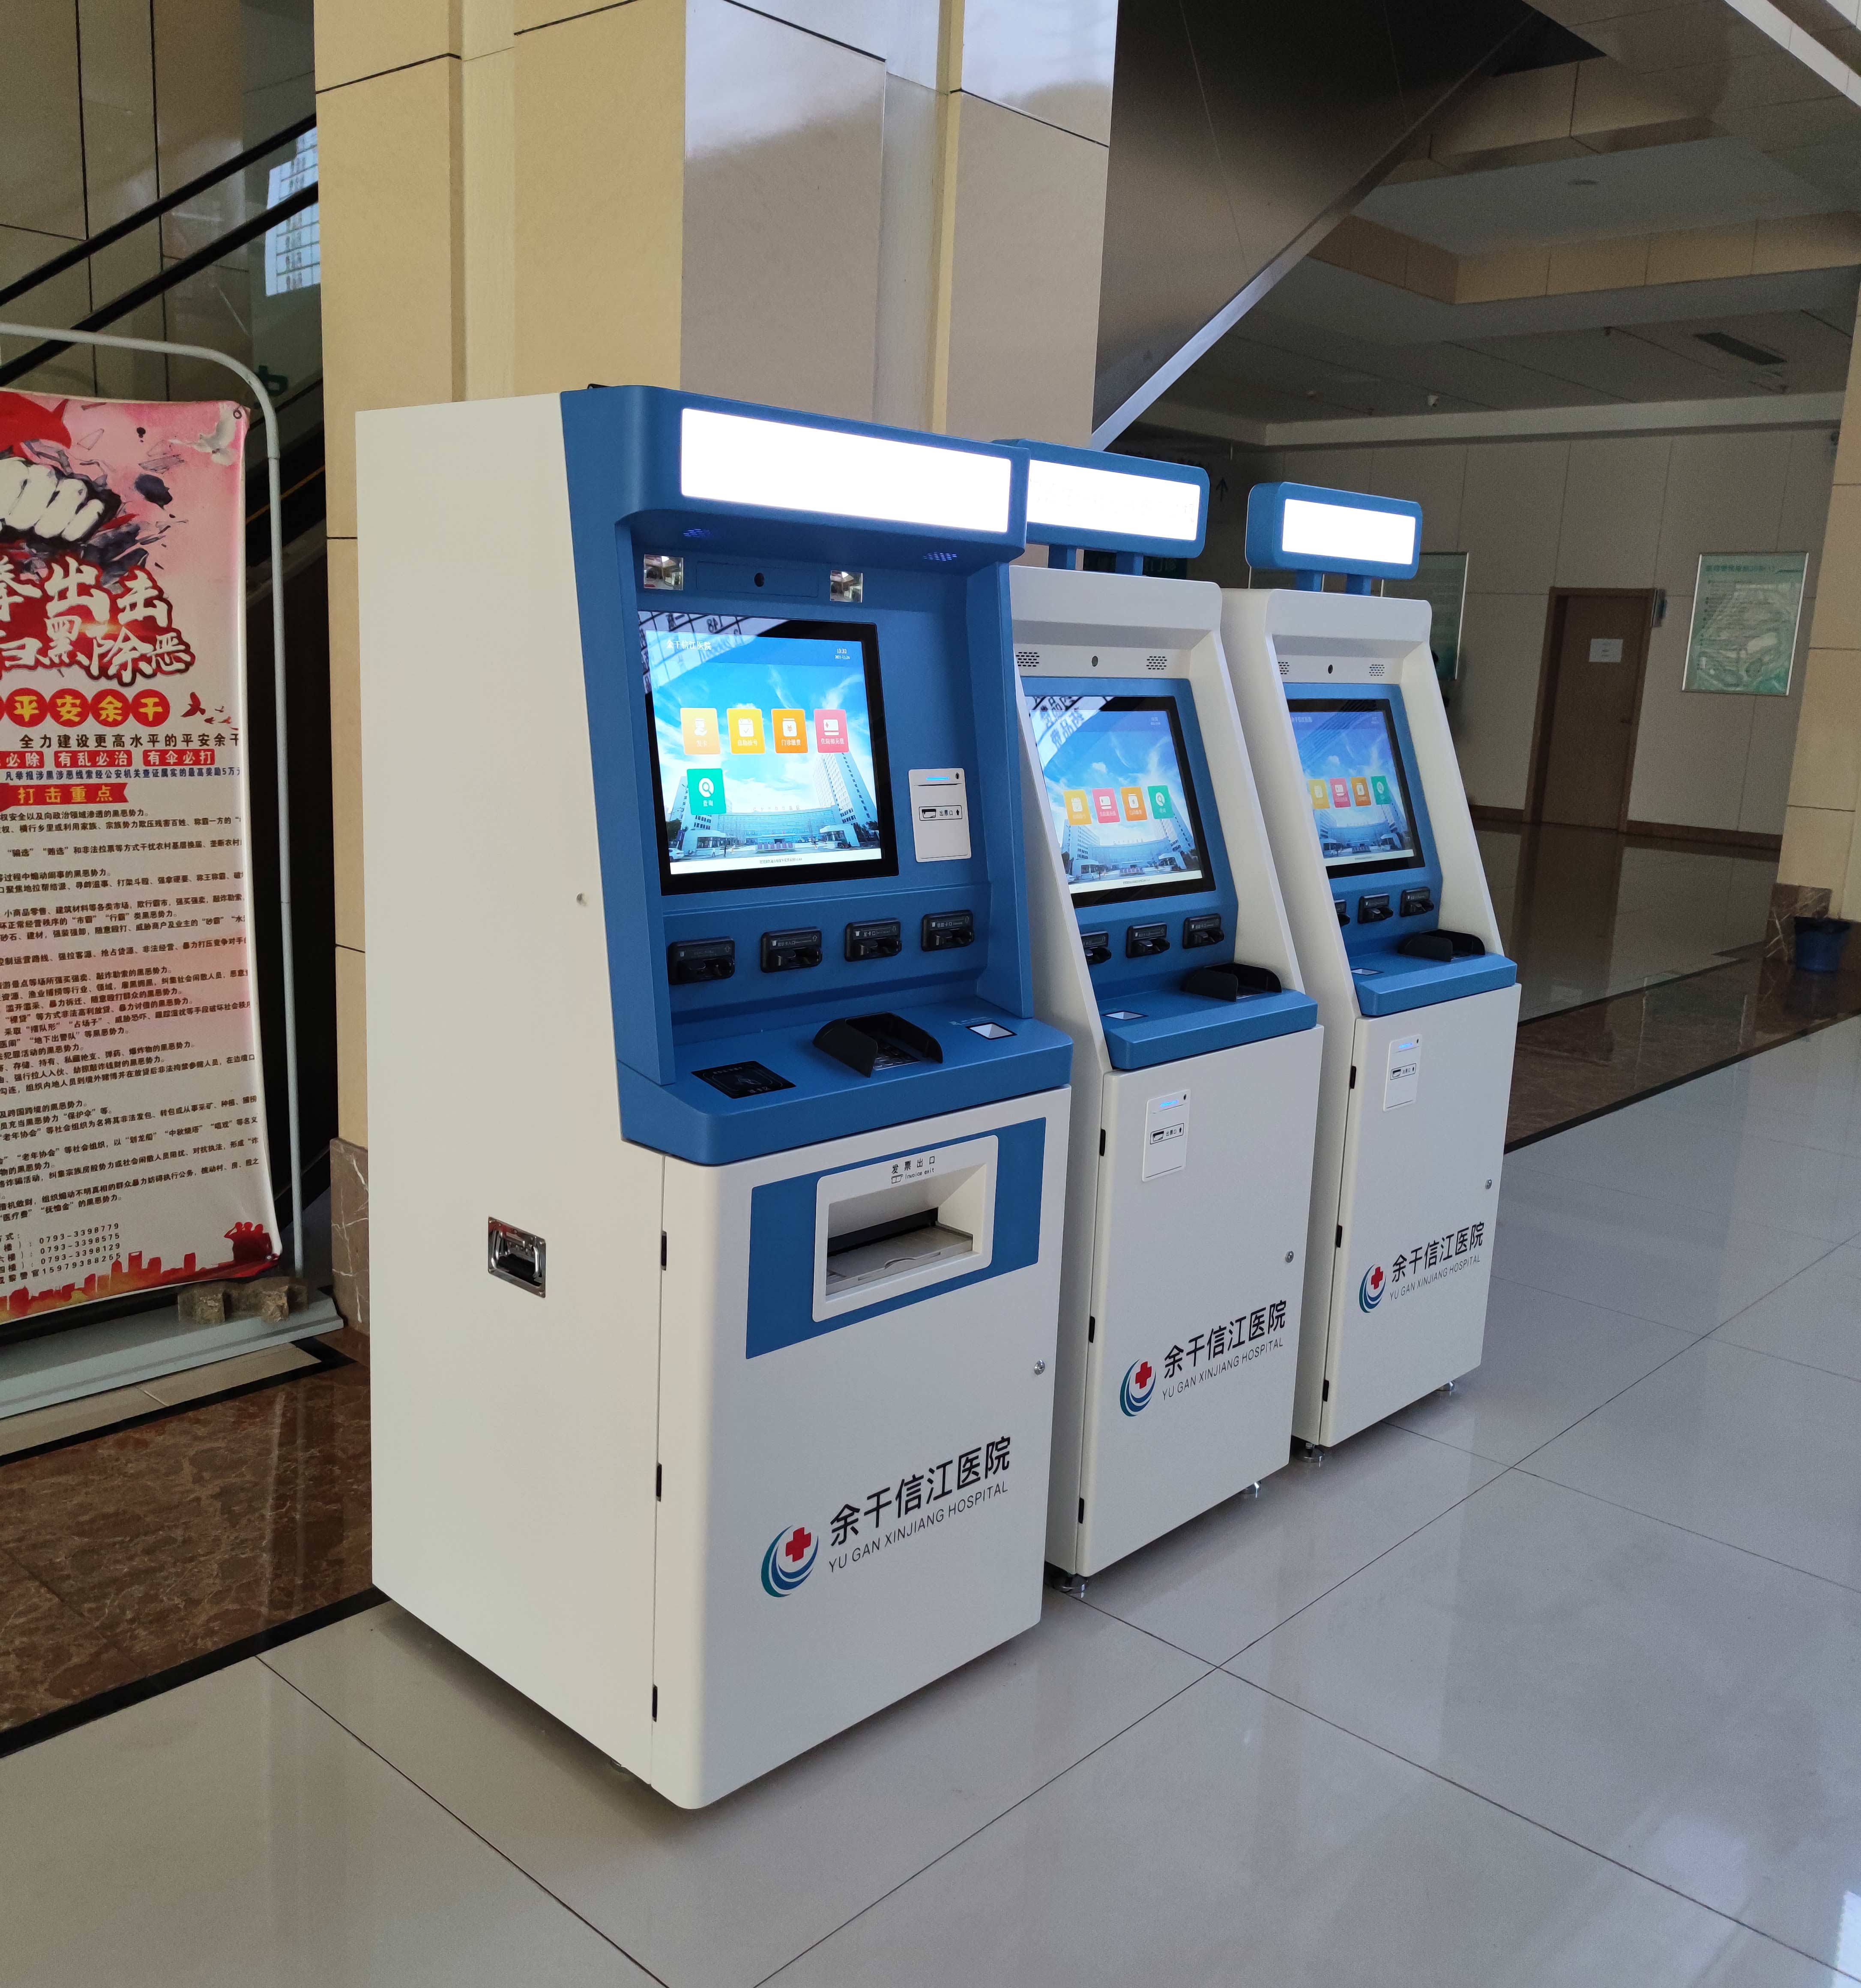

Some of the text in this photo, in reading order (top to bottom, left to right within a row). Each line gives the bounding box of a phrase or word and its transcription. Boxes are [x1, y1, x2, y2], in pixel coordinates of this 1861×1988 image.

[14, 695, 163, 722] 平安余干
[0, 749, 212, 768] 必除 有乱必治 有伞必打
[17, 786, 113, 804] 打击重点
[891, 1156, 935, 1174] 发票出口
[905, 1168, 935, 1180] Invoice exit
[39, 1223, 119, 1244] 0793-3398779
[40, 1233, 120, 1254] 0793-3398575
[41, 1242, 120, 1264] 0793-3398129
[1391, 1221, 1484, 1282] 余干信江医院
[1389, 1254, 1481, 1301] YU GAN XINJIANG HOSPITAL
[1164, 1299, 1287, 1379] 余干信江医院
[1162, 1337, 1284, 1401] YU GAN XINJIANG HOSPITAL
[830, 1436, 1011, 1546] 余干信江医院
[829, 1480, 1008, 1573] YU GAN XINJIANG HOSPITAL
